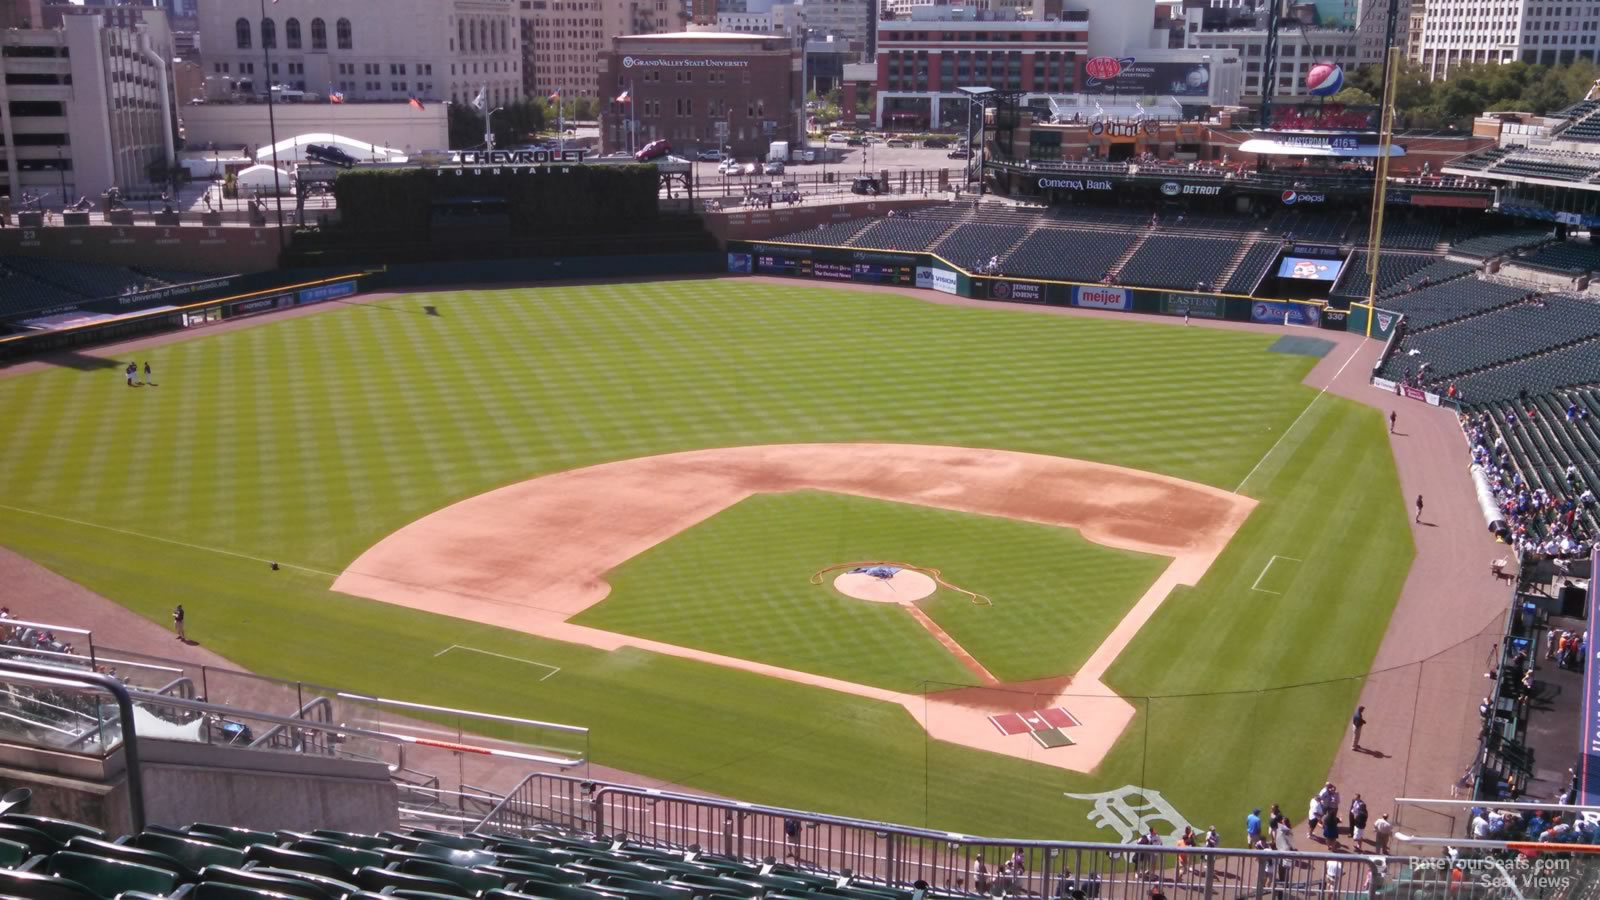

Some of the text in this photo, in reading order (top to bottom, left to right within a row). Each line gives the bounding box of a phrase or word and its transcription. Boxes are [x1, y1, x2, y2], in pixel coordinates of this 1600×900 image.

[633, 58, 749, 68] GRAND VALLEY STATE UNIVERSITY
[1288, 136, 1329, 147] AMSTERDAM
[1332, 138, 1349, 148] 416
[460, 149, 586, 164] CHEVROLET
[437, 167, 570, 176] FOUNTAIN
[1086, 179, 1112, 190] Bank
[1183, 185, 1222, 195] DETROIT
[1298, 194, 1325, 203] pepsi
[935, 275, 957, 286] VISION
[1012, 283, 1040, 292] JIMMY
[118, 296, 131, 305] The
[132, 291, 163, 304] University
[1012, 290, 1039, 299] JOHN'S
[1082, 290, 1121, 305] meijer
[1168, 293, 1217, 307] EASTERN
